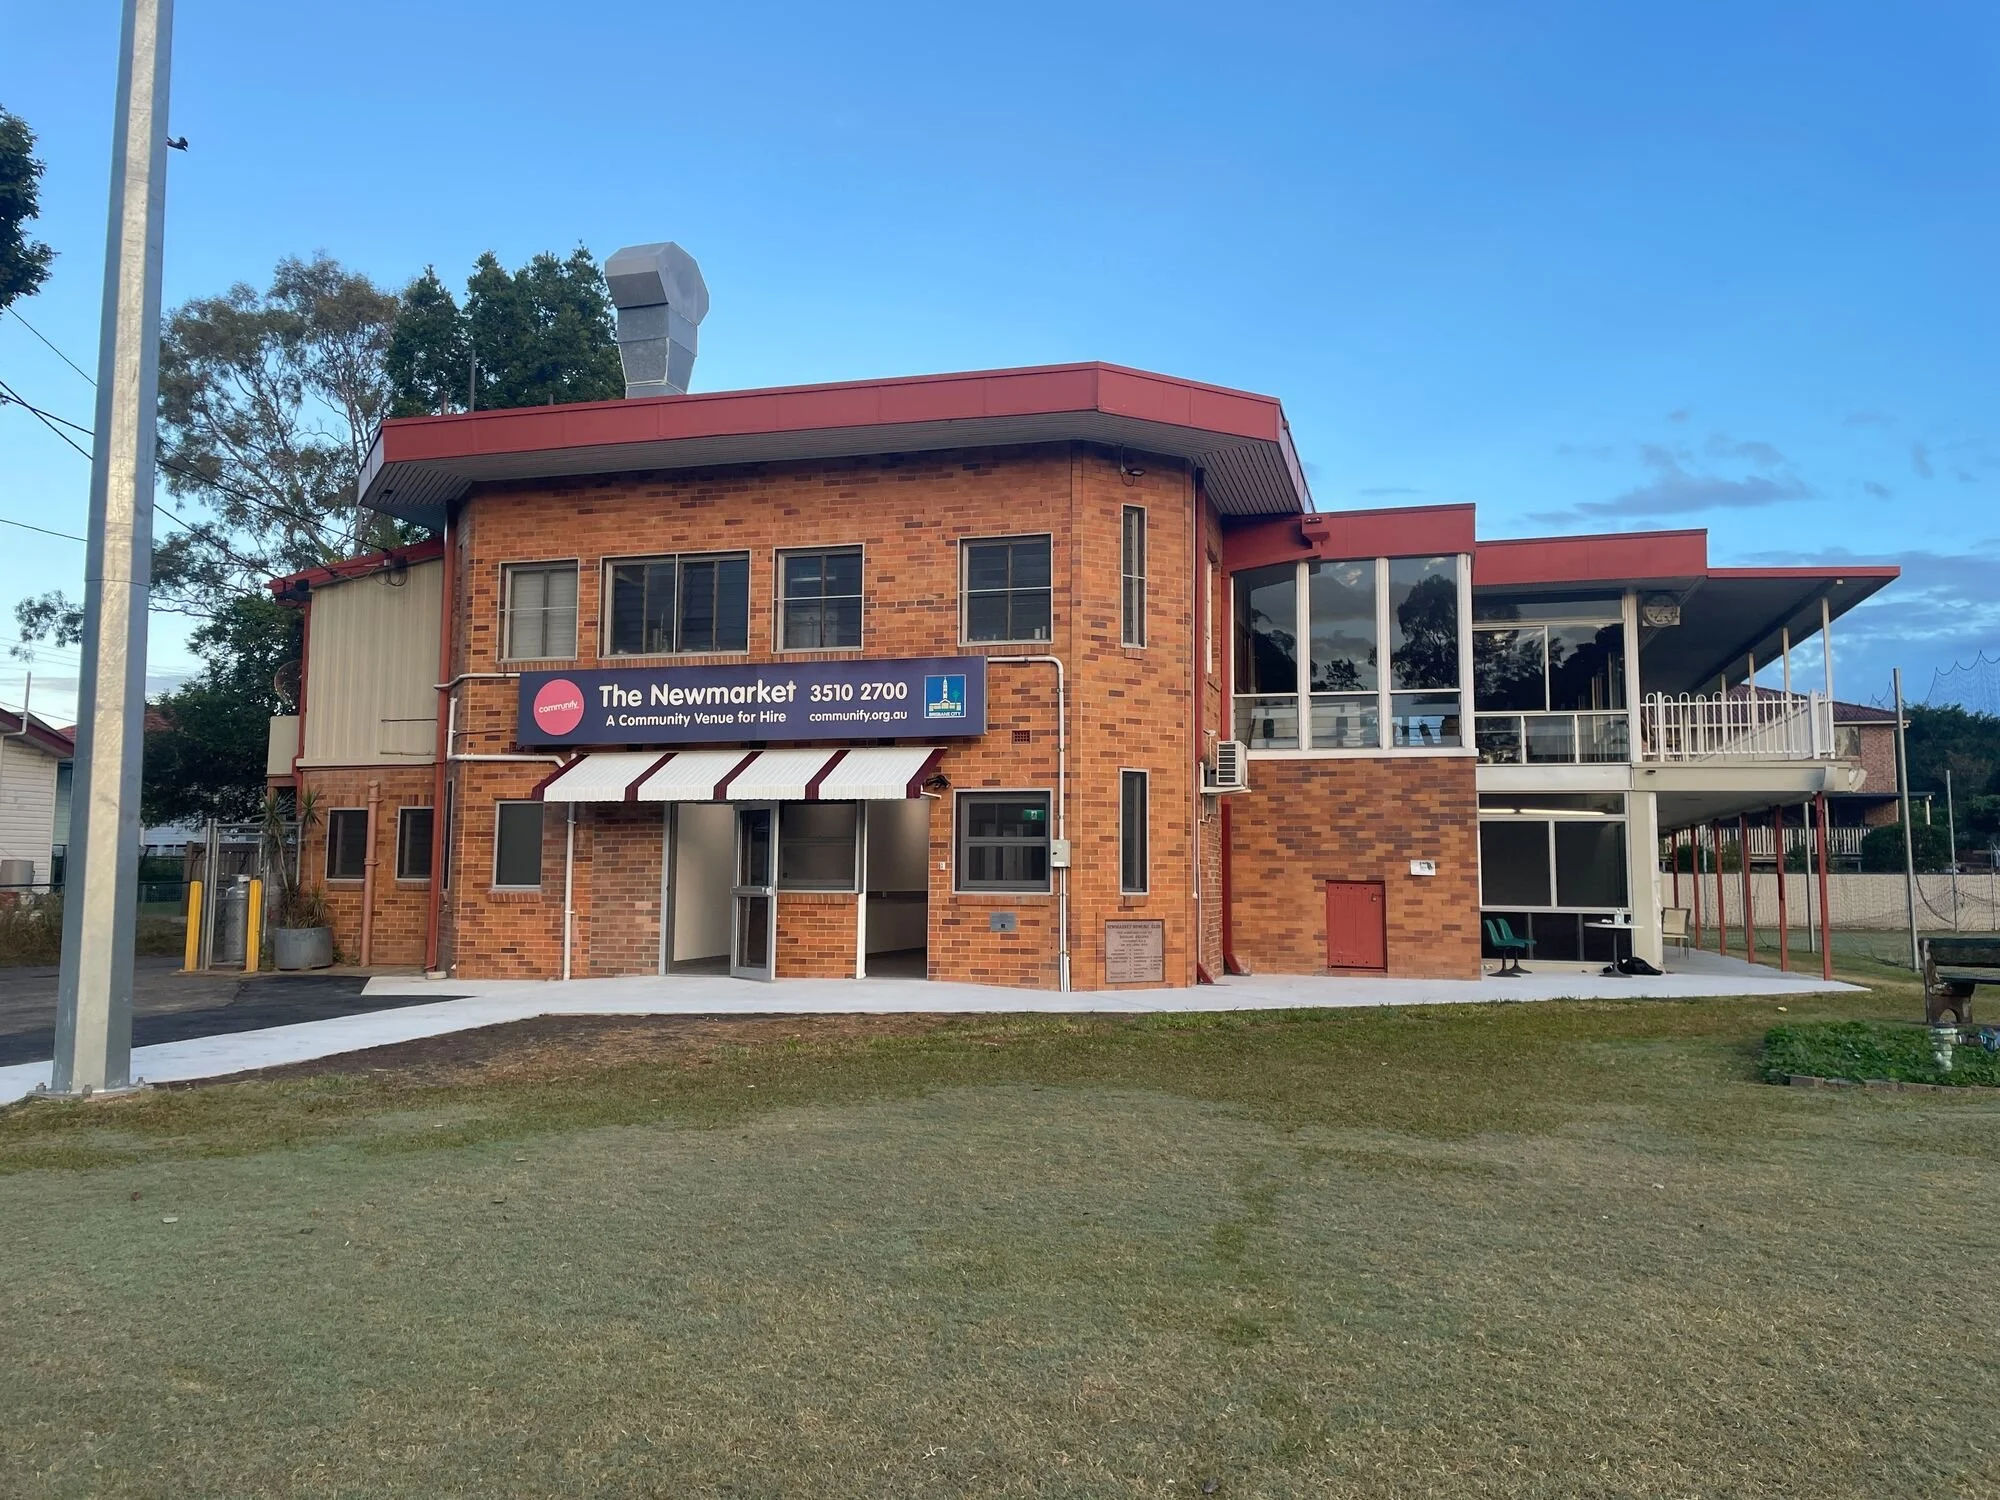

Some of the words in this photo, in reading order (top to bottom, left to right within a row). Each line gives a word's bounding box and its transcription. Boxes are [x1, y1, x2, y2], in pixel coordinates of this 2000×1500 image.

[599, 684, 643, 707] The
[651, 680, 797, 706] Newmarket
[810, 684, 854, 702] 3510
[861, 682, 908, 701] 2700
[605, 714, 616, 727] A
[618, 712, 691, 728] Community
[694, 712, 734, 725] Venue
[738, 710, 757, 724] for
[760, 710, 787, 723] Hire
[809, 709, 908, 722] communify.org.au
